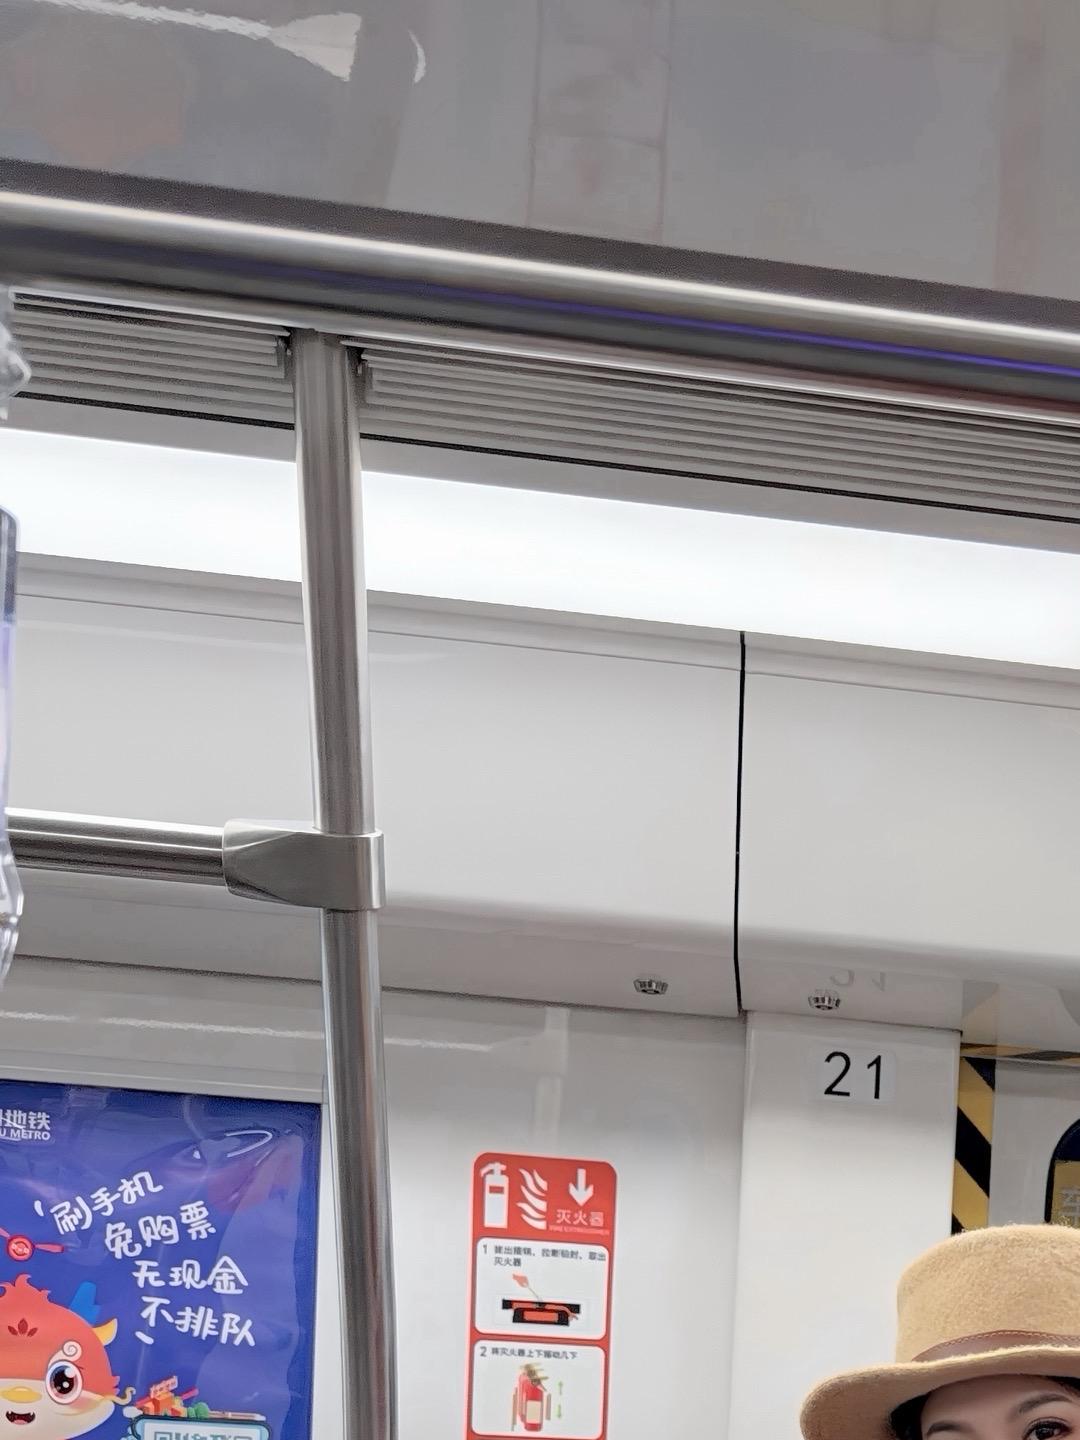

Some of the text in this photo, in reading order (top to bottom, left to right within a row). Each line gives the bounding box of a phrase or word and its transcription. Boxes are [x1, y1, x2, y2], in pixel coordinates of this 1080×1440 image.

[824, 1051, 882, 1100] 21
[10, 1128, 51, 1141] METRO
[50, 1171, 163, 1235] 刷手机
[556, 1209, 605, 1227] 灭火器
[104, 1200, 216, 1260] 免购票
[132, 1255, 248, 1295] 无现金
[494, 1256, 522, 1268] 灭火器
[140, 1295, 256, 1347] 不排队
[480, 1346, 487, 1357] 2
